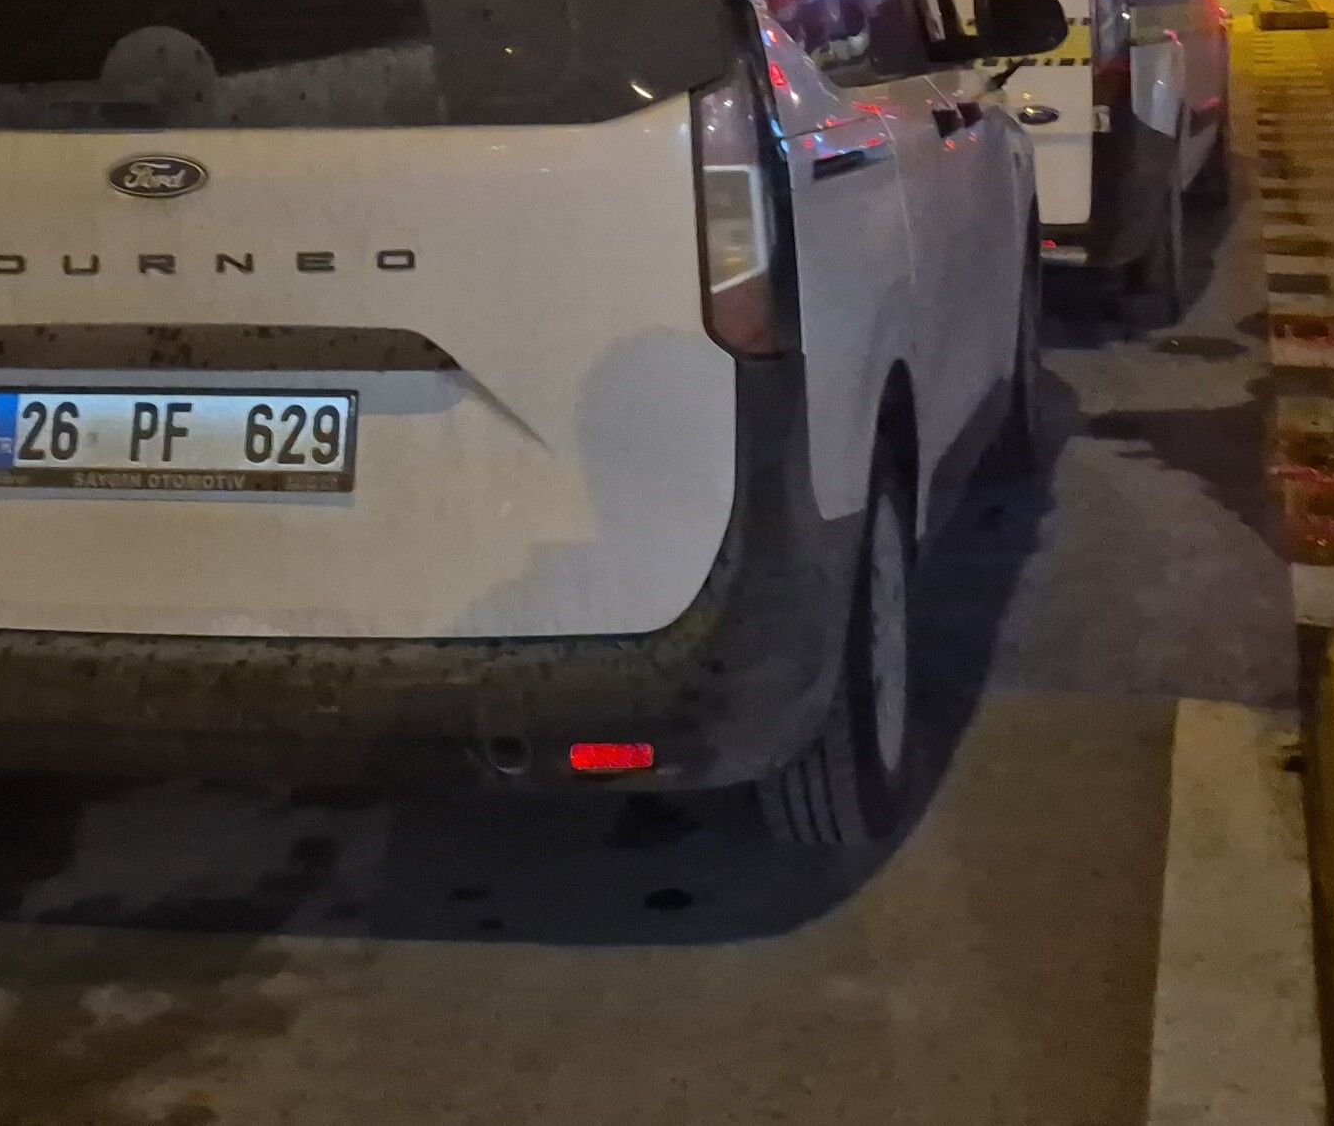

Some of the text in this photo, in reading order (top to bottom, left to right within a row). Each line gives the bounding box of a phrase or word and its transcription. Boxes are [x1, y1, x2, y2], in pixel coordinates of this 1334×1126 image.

[123, 162, 186, 188] Ford
[17, 400, 342, 465] 26 PF 629
